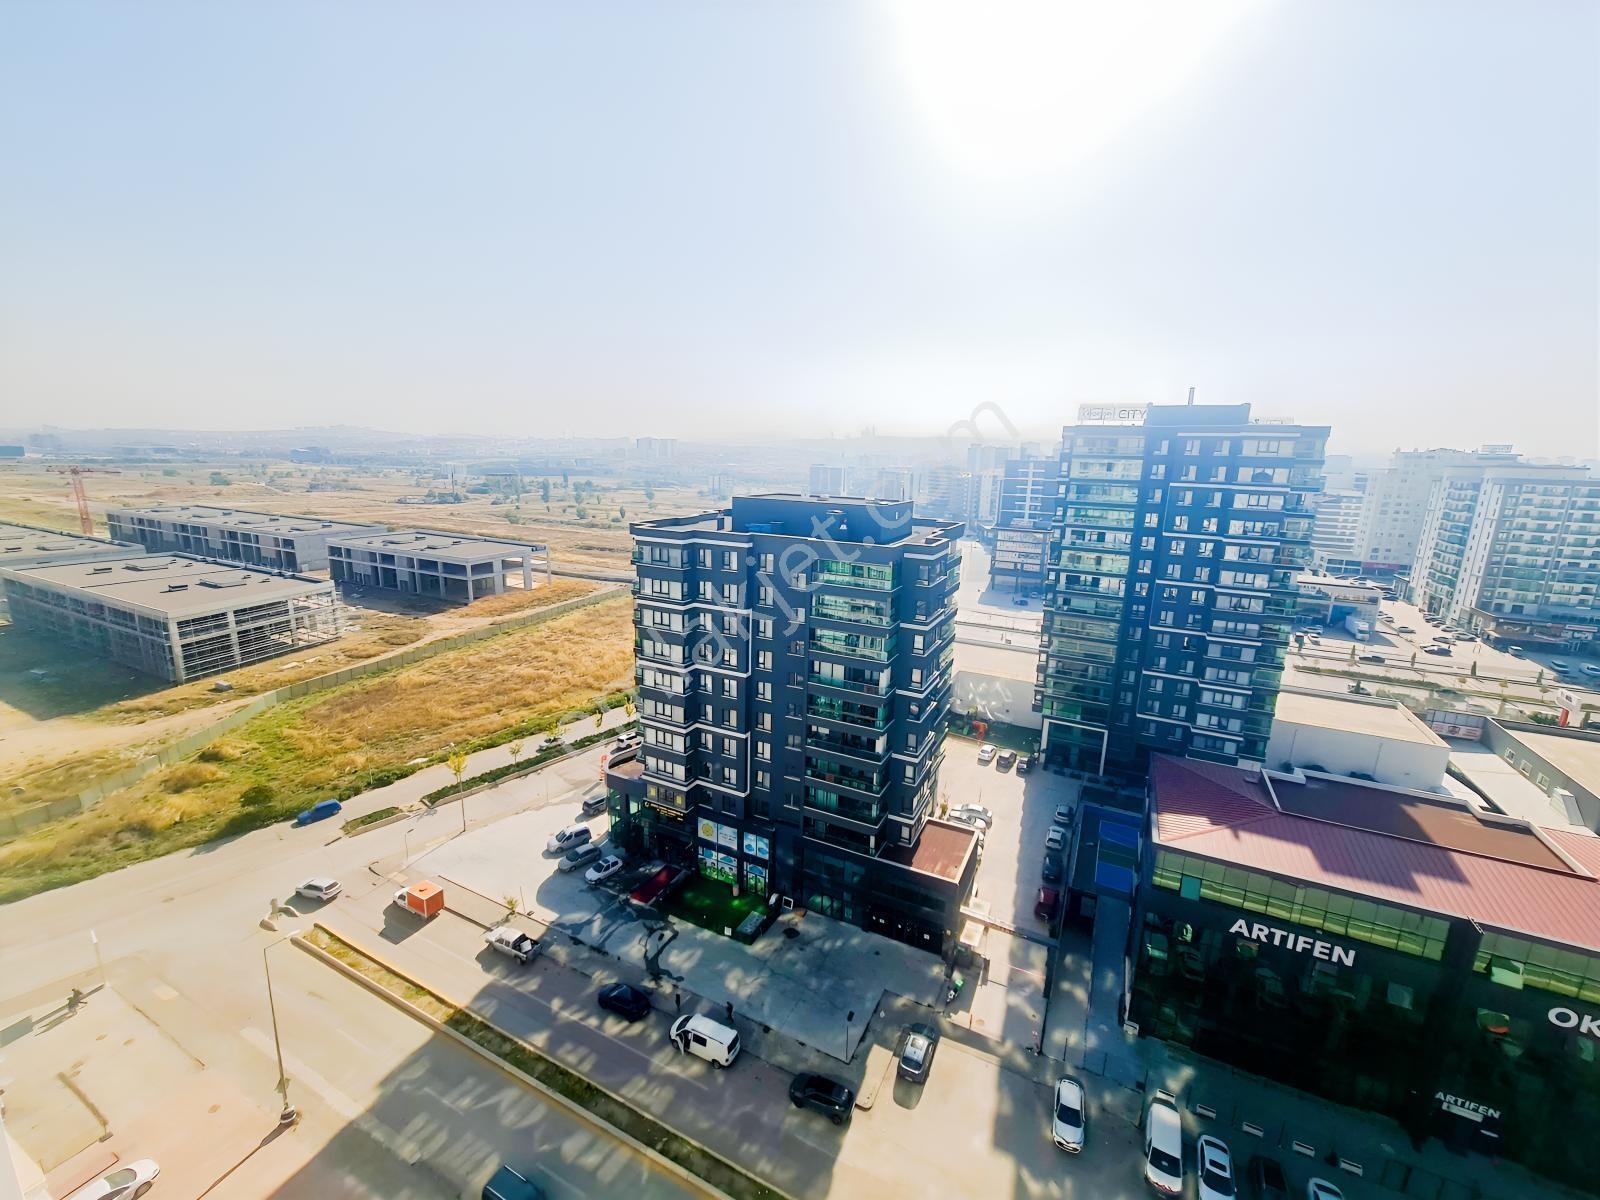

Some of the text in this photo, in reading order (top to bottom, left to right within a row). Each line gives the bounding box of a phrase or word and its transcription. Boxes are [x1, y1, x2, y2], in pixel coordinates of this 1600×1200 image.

[1118, 409, 1147, 419] CITY
[1229, 919, 1356, 967] ARTIFEN
[1435, 1091, 1501, 1119] ARTIFEN
